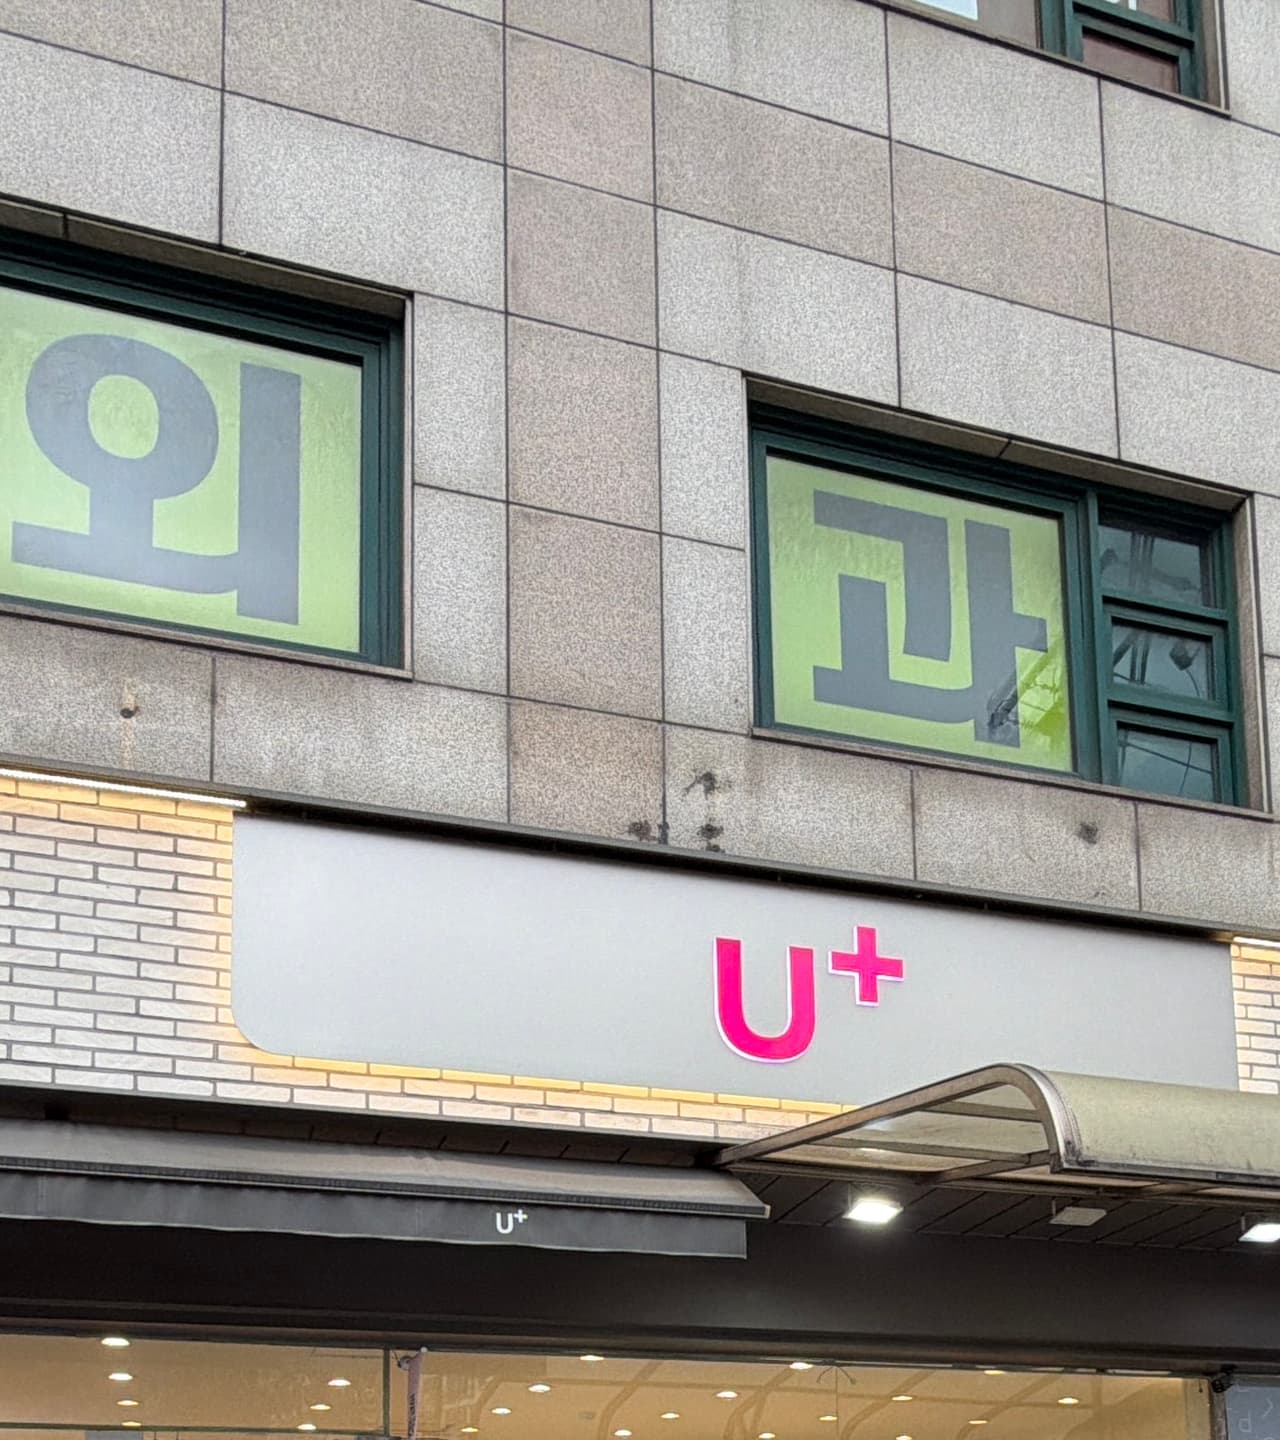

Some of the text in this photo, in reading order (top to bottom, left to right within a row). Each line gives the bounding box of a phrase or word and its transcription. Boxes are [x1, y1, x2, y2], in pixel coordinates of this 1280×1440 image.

[12, 333, 1050, 749] 외 과
[715, 924, 906, 1063] U+
[494, 1207, 528, 1235] U+
